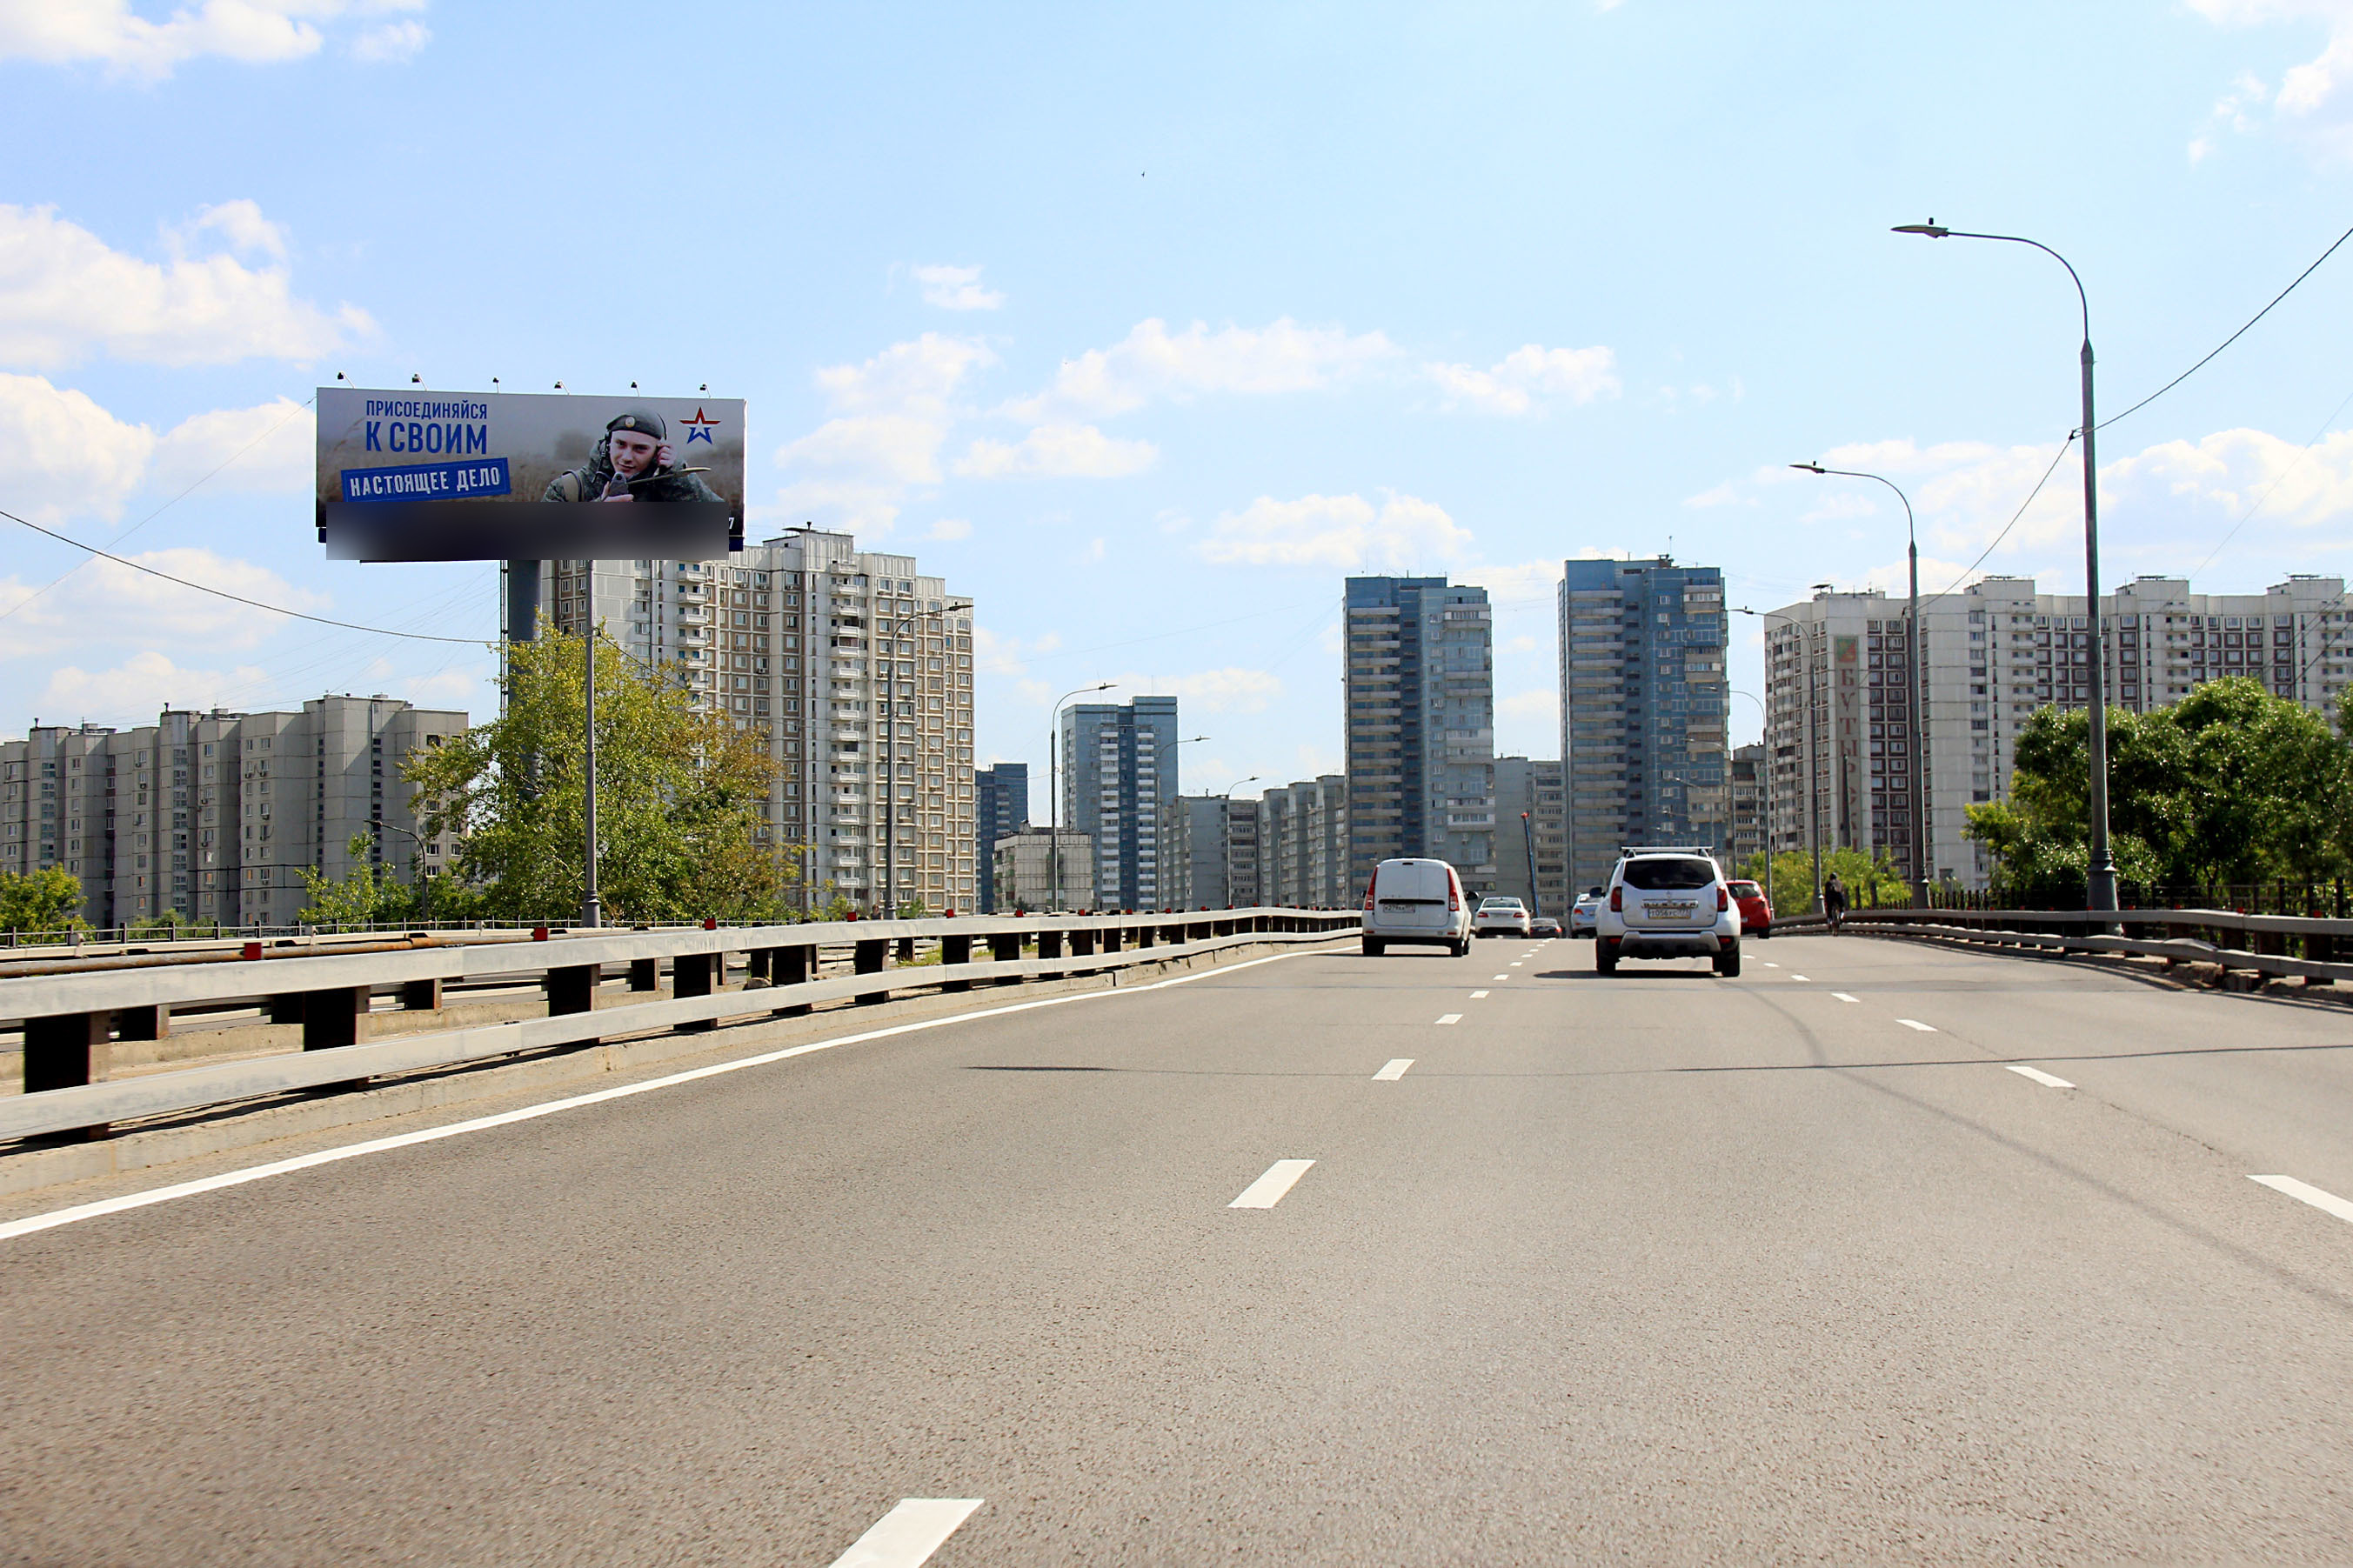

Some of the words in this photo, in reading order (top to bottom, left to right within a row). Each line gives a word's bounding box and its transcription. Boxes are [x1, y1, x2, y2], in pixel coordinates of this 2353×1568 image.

[366, 400, 487, 419] ПРИСОЕДИНЯЙСЯ
[366, 421, 382, 451] К
[390, 422, 487, 454] СВОИМ
[350, 471, 449, 497] НАСТОЯЩЕЕ
[457, 467, 500, 491] ДЕЛО
